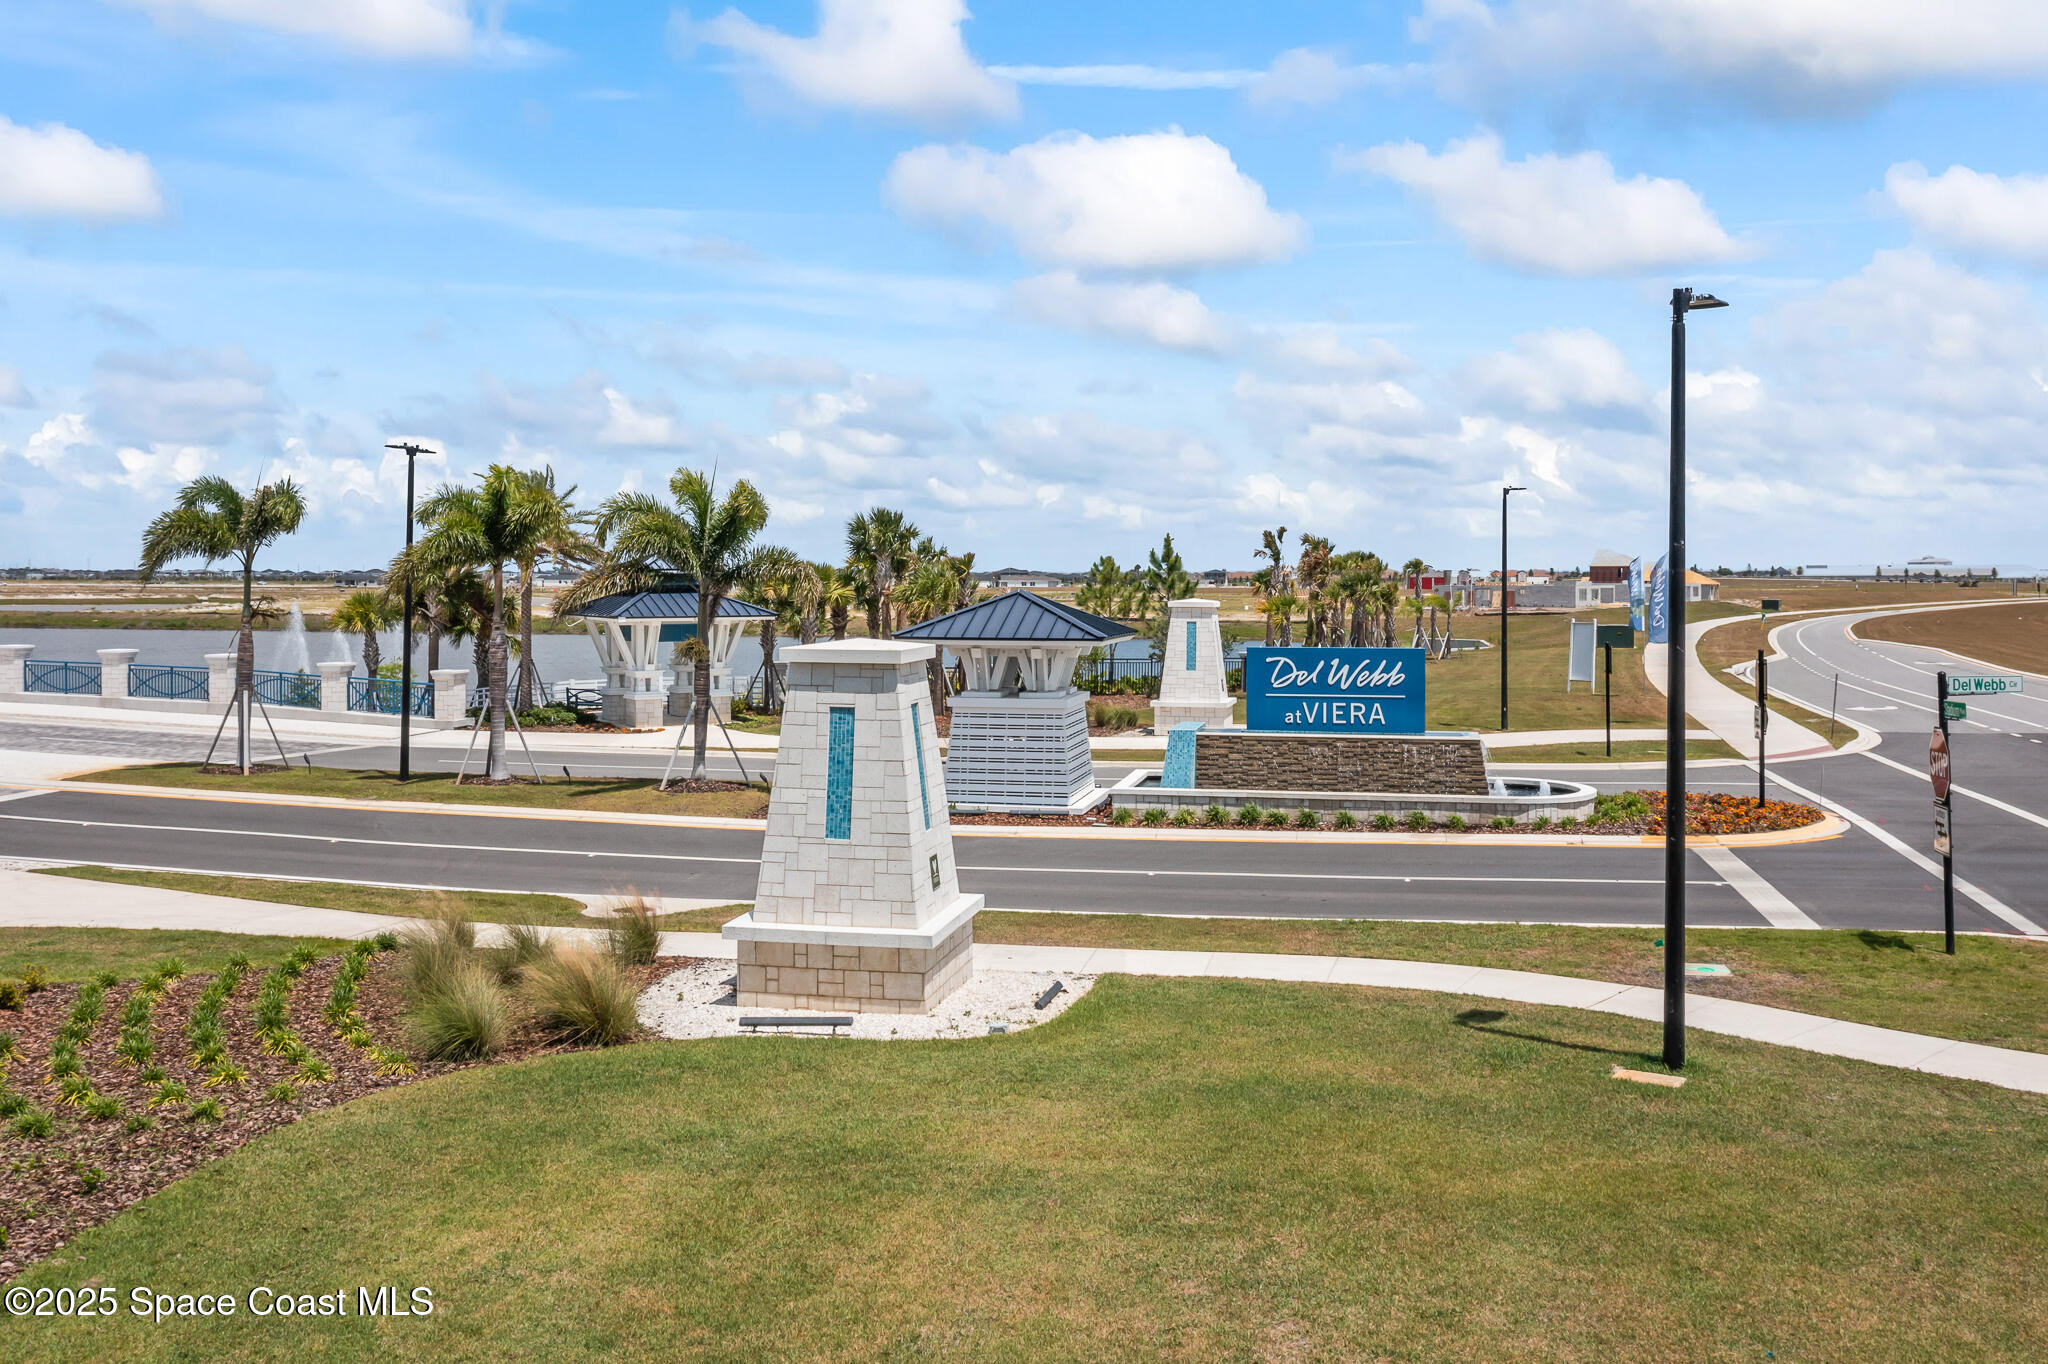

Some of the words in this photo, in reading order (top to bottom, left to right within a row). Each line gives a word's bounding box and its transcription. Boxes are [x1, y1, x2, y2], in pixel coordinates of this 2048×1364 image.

[1265, 656, 1325, 688] Del
[1327, 658, 1406, 690] Webb
[1953, 678, 1971, 691] Del
[1974, 678, 2006, 691] Webb
[1284, 710, 1302, 724] at
[1302, 702, 1386, 725] VIERA
[1930, 751, 1948, 778] STOP
